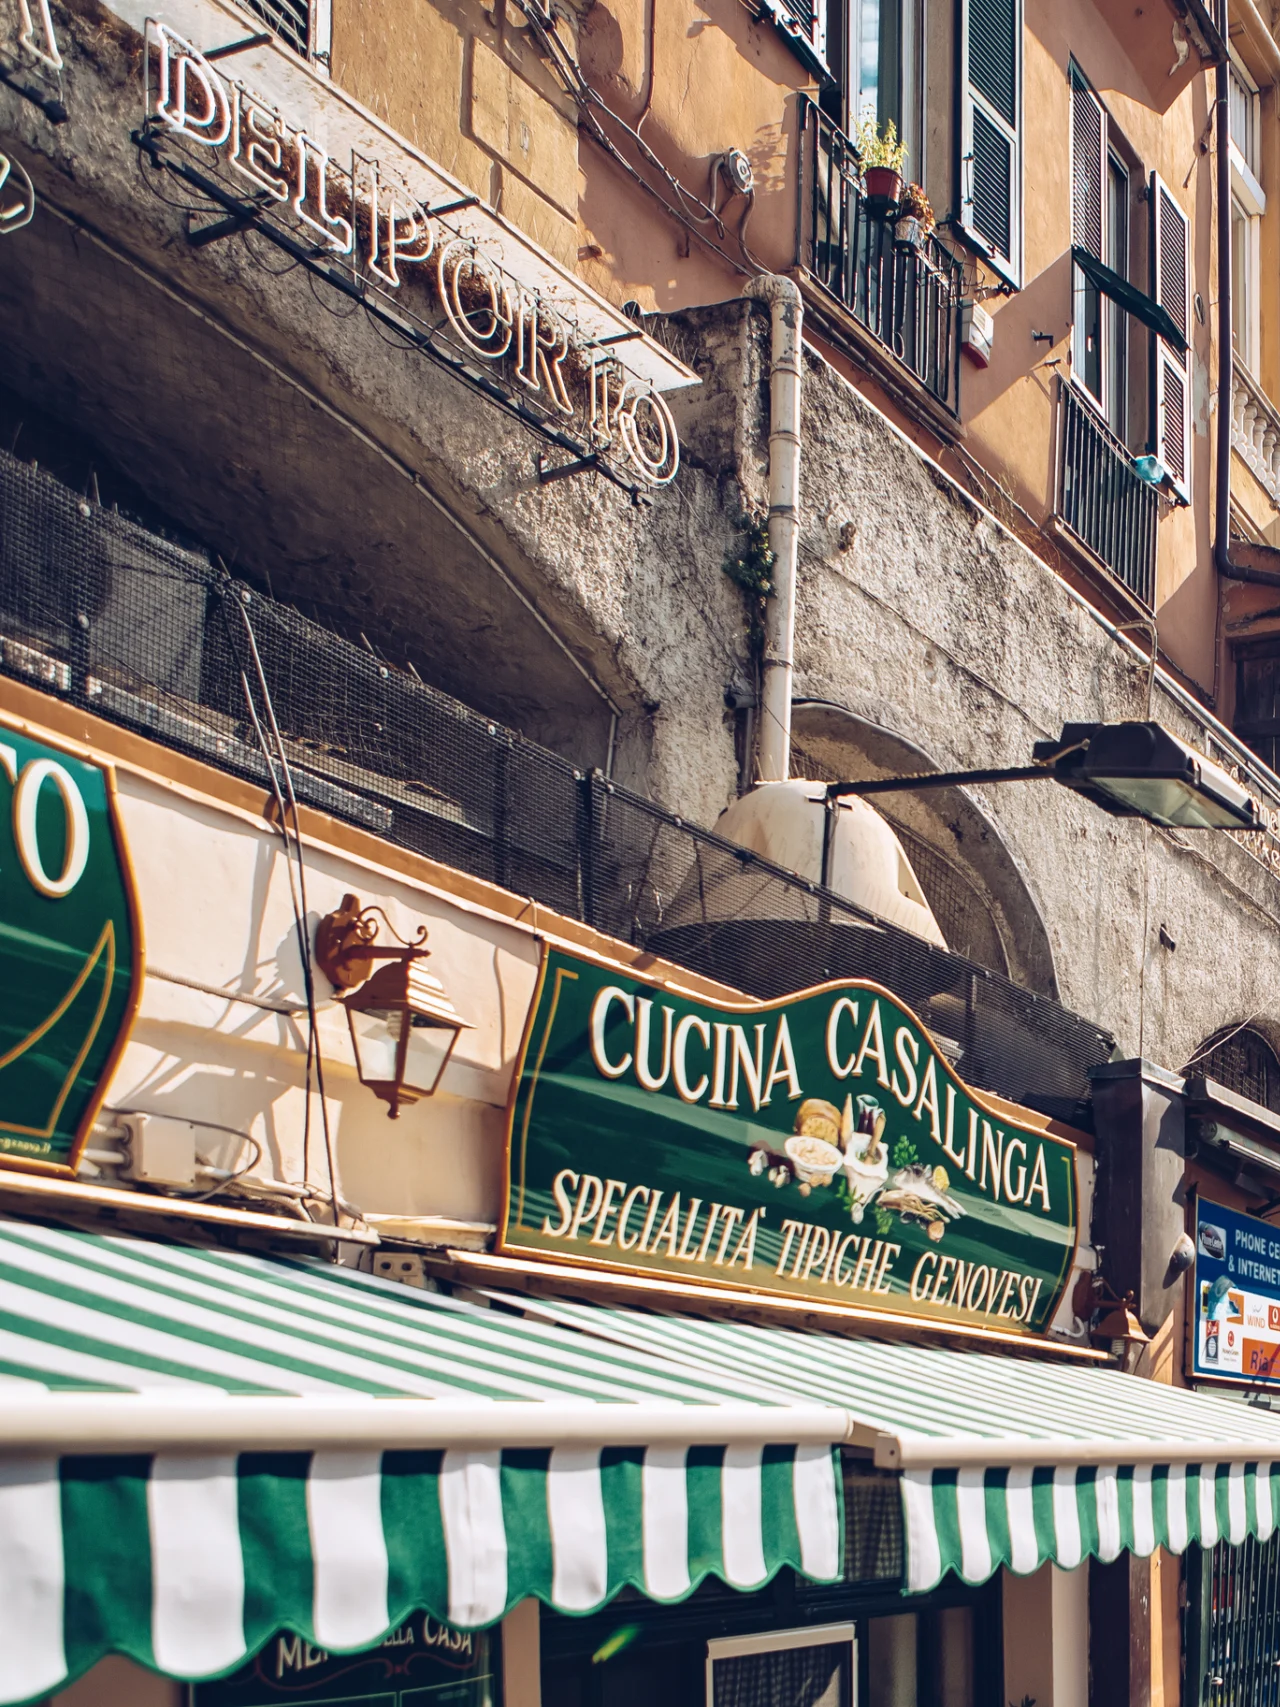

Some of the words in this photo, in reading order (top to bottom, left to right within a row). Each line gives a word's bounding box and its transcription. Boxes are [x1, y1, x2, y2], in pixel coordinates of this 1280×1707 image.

[157, 23, 353, 254] DEL
[366, 157, 680, 487] PORTO
[589, 985, 804, 1112] CUCINA
[825, 997, 1052, 1213] CASALINGA
[1234, 1228, 1267, 1256] PHONE
[775, 1219, 902, 1296] TIPICHE
[909, 1251, 1044, 1324] GENOVESI
[1227, 1254, 1236, 1273] &
[1247, 1313, 1267, 1330] WIND
[1250, 1345, 1268, 1372] Ria
